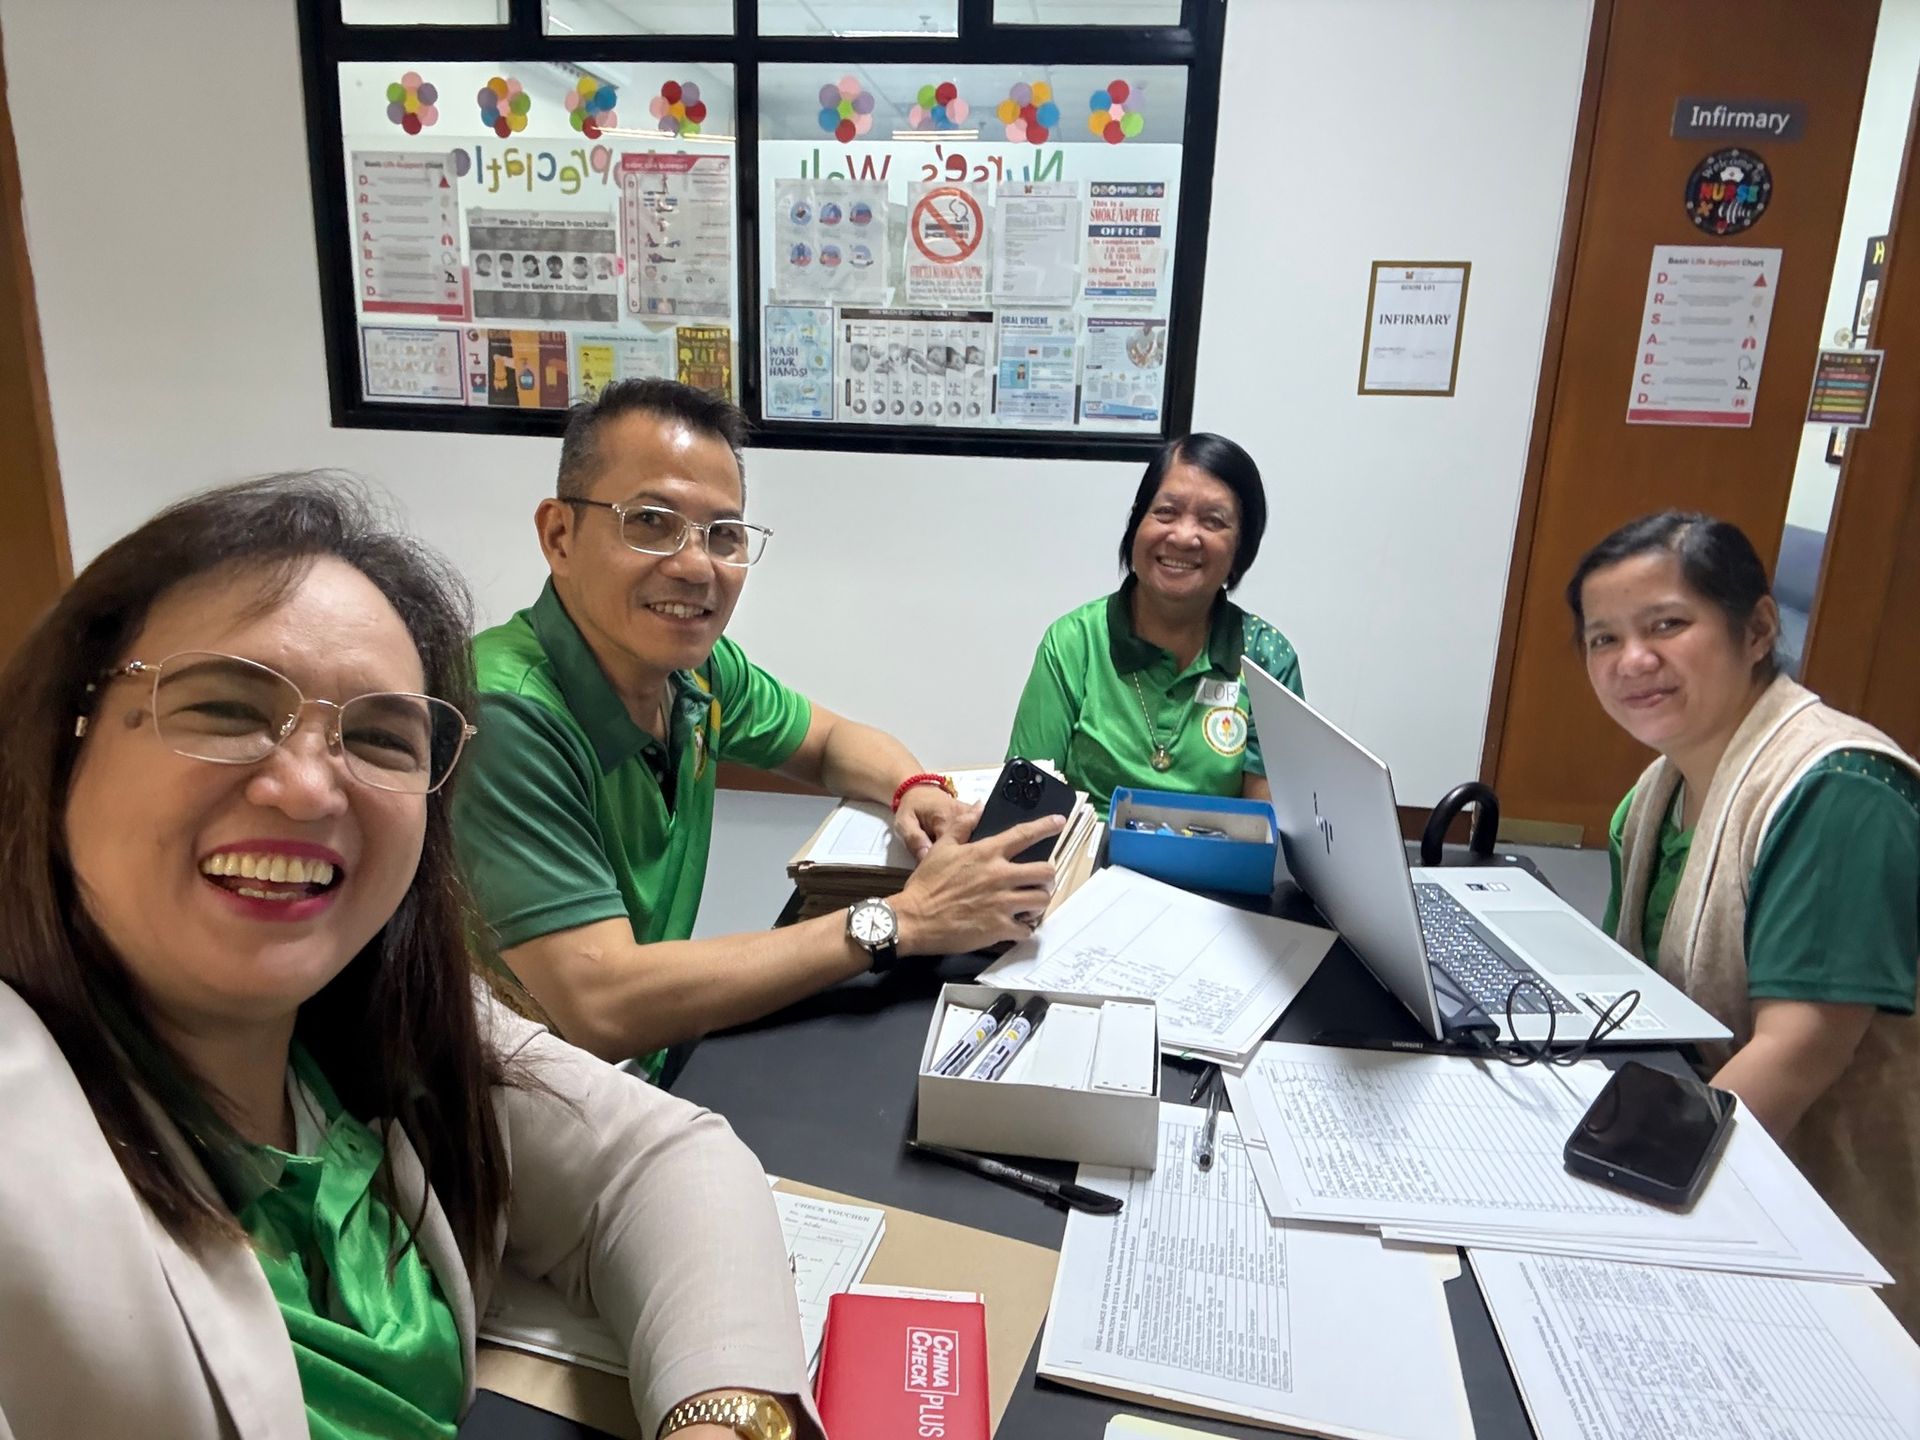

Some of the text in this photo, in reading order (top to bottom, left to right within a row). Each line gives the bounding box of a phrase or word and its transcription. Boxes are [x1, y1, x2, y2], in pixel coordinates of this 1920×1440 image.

[1690, 105, 1791, 135] Infirmary
[1141, 208, 1160, 222] FREE
[363, 231, 372, 242] A
[1100, 227, 1146, 236] OFFICE
[1668, 257, 1764, 268] Basic Life Support Chart
[365, 268, 374, 279] C
[1656, 272, 1668, 284] D
[1654, 292, 1665, 304] R
[1001, 316, 1049, 325] ORAL HYGIENE
[1379, 313, 1451, 325] INFIRMARY
[1651, 313, 1661, 325] S
[1646, 333, 1658, 345] A
[769, 346, 798, 356] WASH
[769, 357, 796, 367] YOUR
[1643, 353, 1654, 366] B
[769, 367, 808, 377] HANDS!
[1641, 373, 1652, 385] C
[1637, 393, 1649, 405] D
[794, 1202, 825, 1213] CHECK
[827, 1209, 871, 1223] VOUCHER
[910, 1331, 933, 1388] CHECK
[932, 1335, 954, 1388] CHINA
[918, 1394, 945, 1438] PLUS
